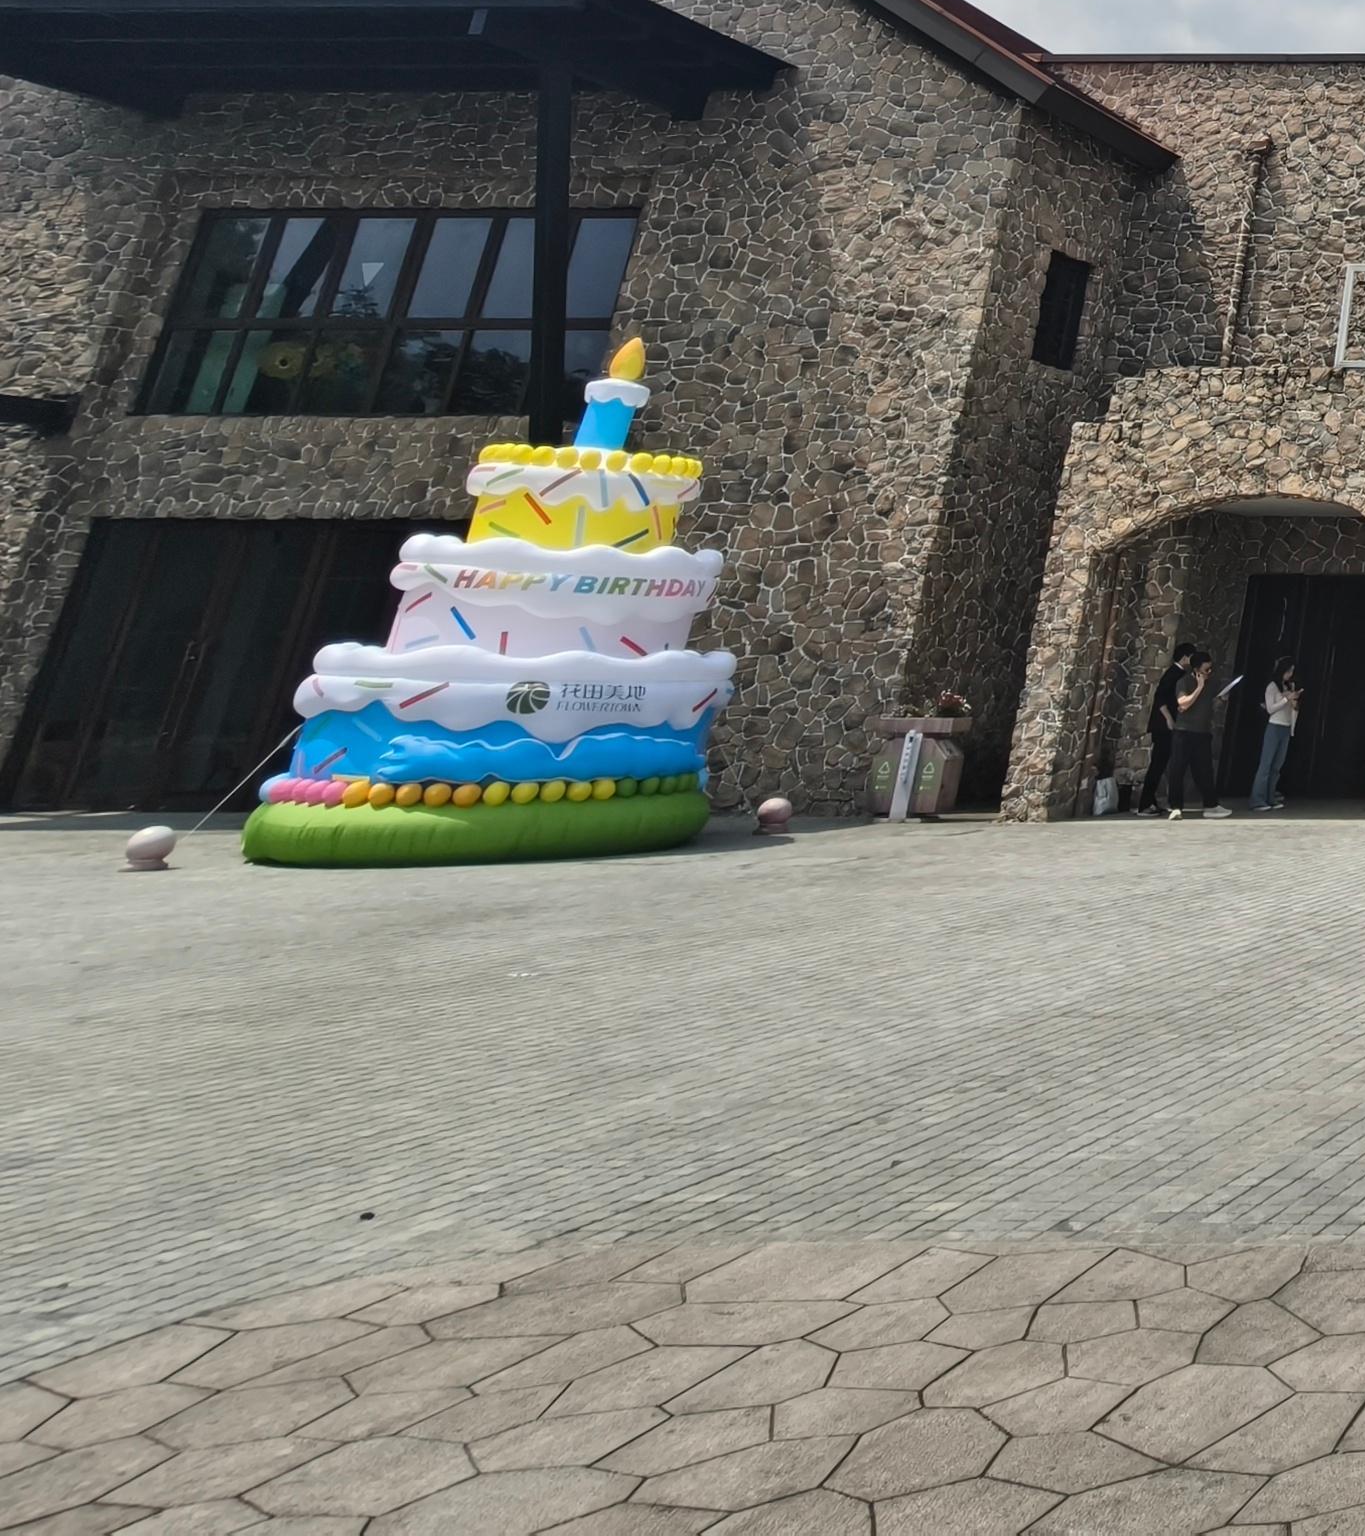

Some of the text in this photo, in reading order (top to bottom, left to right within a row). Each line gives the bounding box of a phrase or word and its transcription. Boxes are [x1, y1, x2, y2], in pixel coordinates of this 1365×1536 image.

[453, 569, 706, 598] HAPPY BIRTHDAY
[560, 682, 647, 701] 花田美地
[556, 701, 642, 713] FLOWERTOWN
